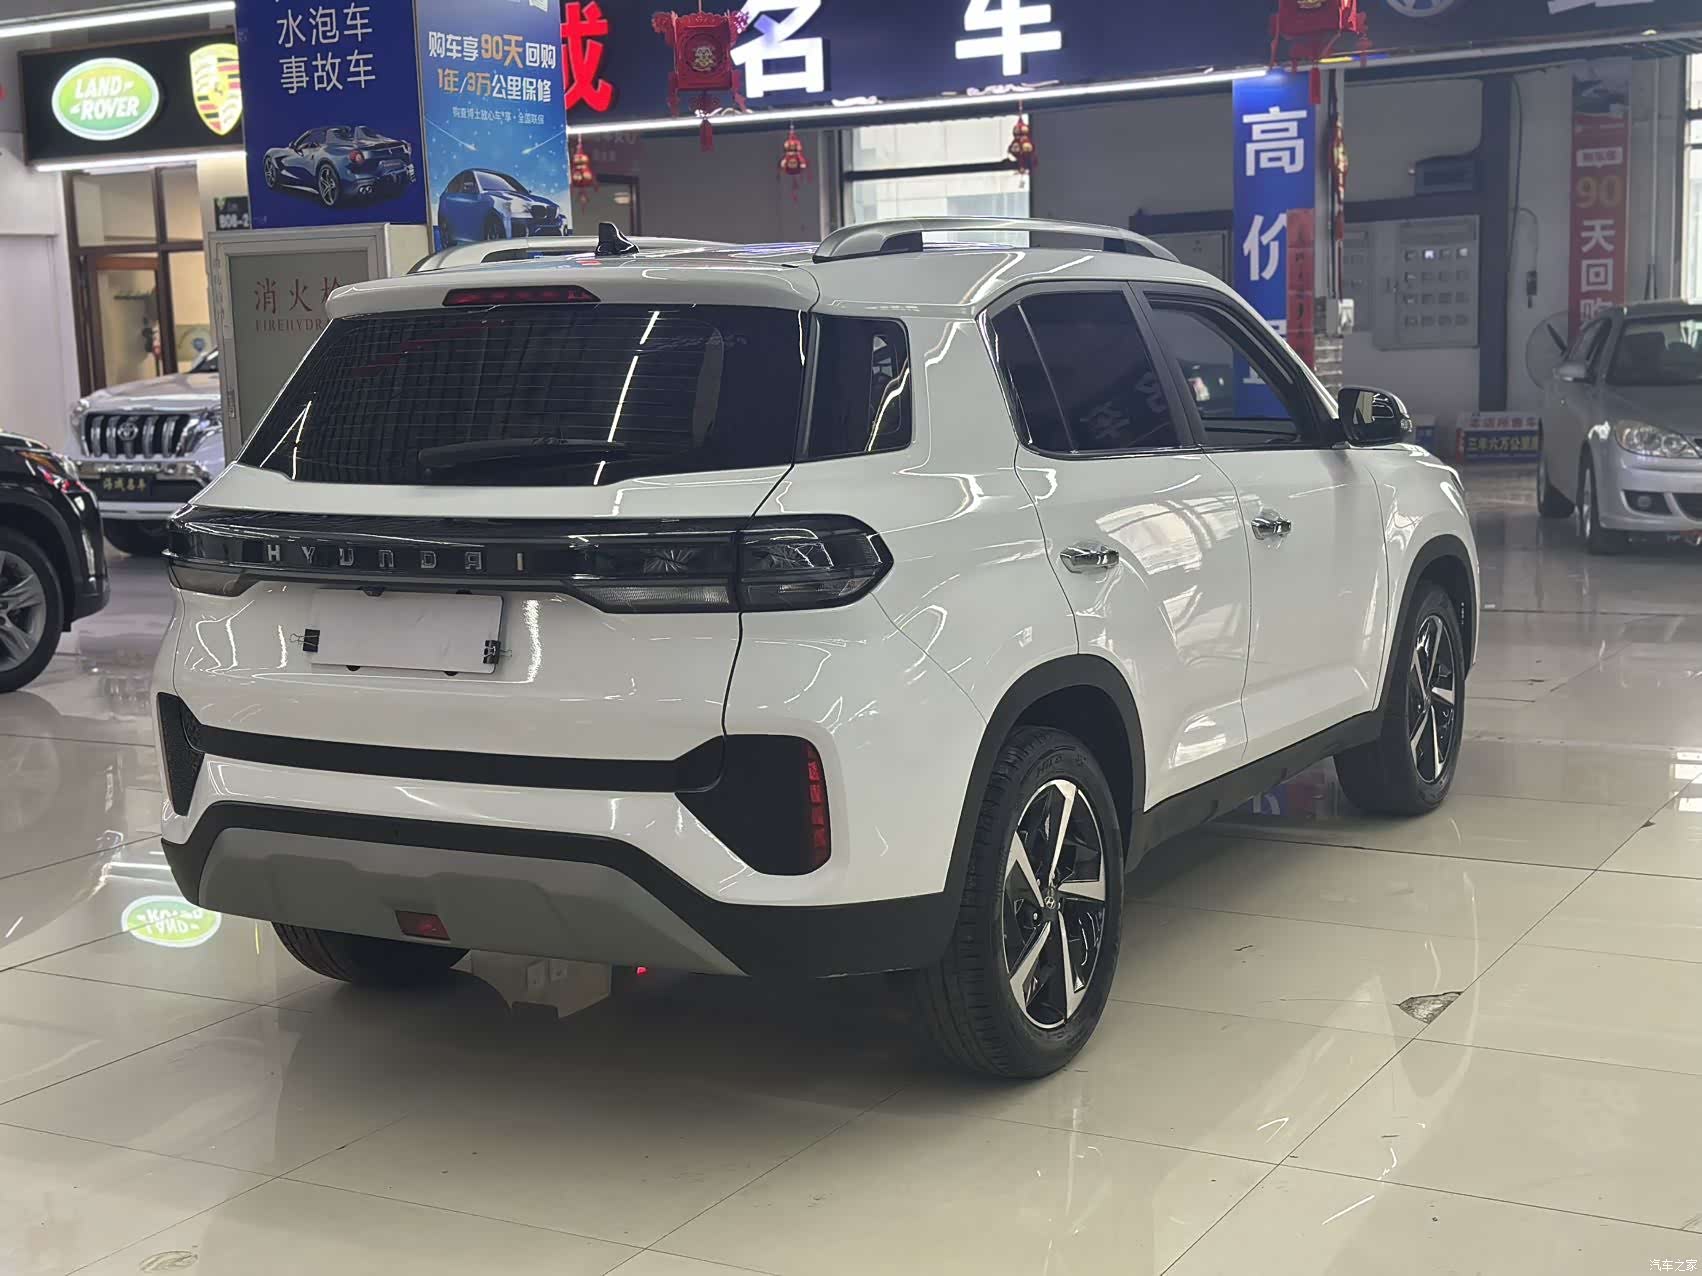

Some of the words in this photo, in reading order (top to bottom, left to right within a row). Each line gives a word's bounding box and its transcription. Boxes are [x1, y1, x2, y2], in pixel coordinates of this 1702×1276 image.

[276, 3, 373, 48] 水泡车
[428, 31, 556, 69] 购车享90天回购
[75, 76, 122, 99] LAND
[279, 49, 376, 94] 事故车
[437, 67, 551, 102] 1年/3万公里保修
[80, 96, 140, 121] ROVER
[1242, 105, 1308, 385] 高价
[266, 544, 524, 572] HYUNDAI
